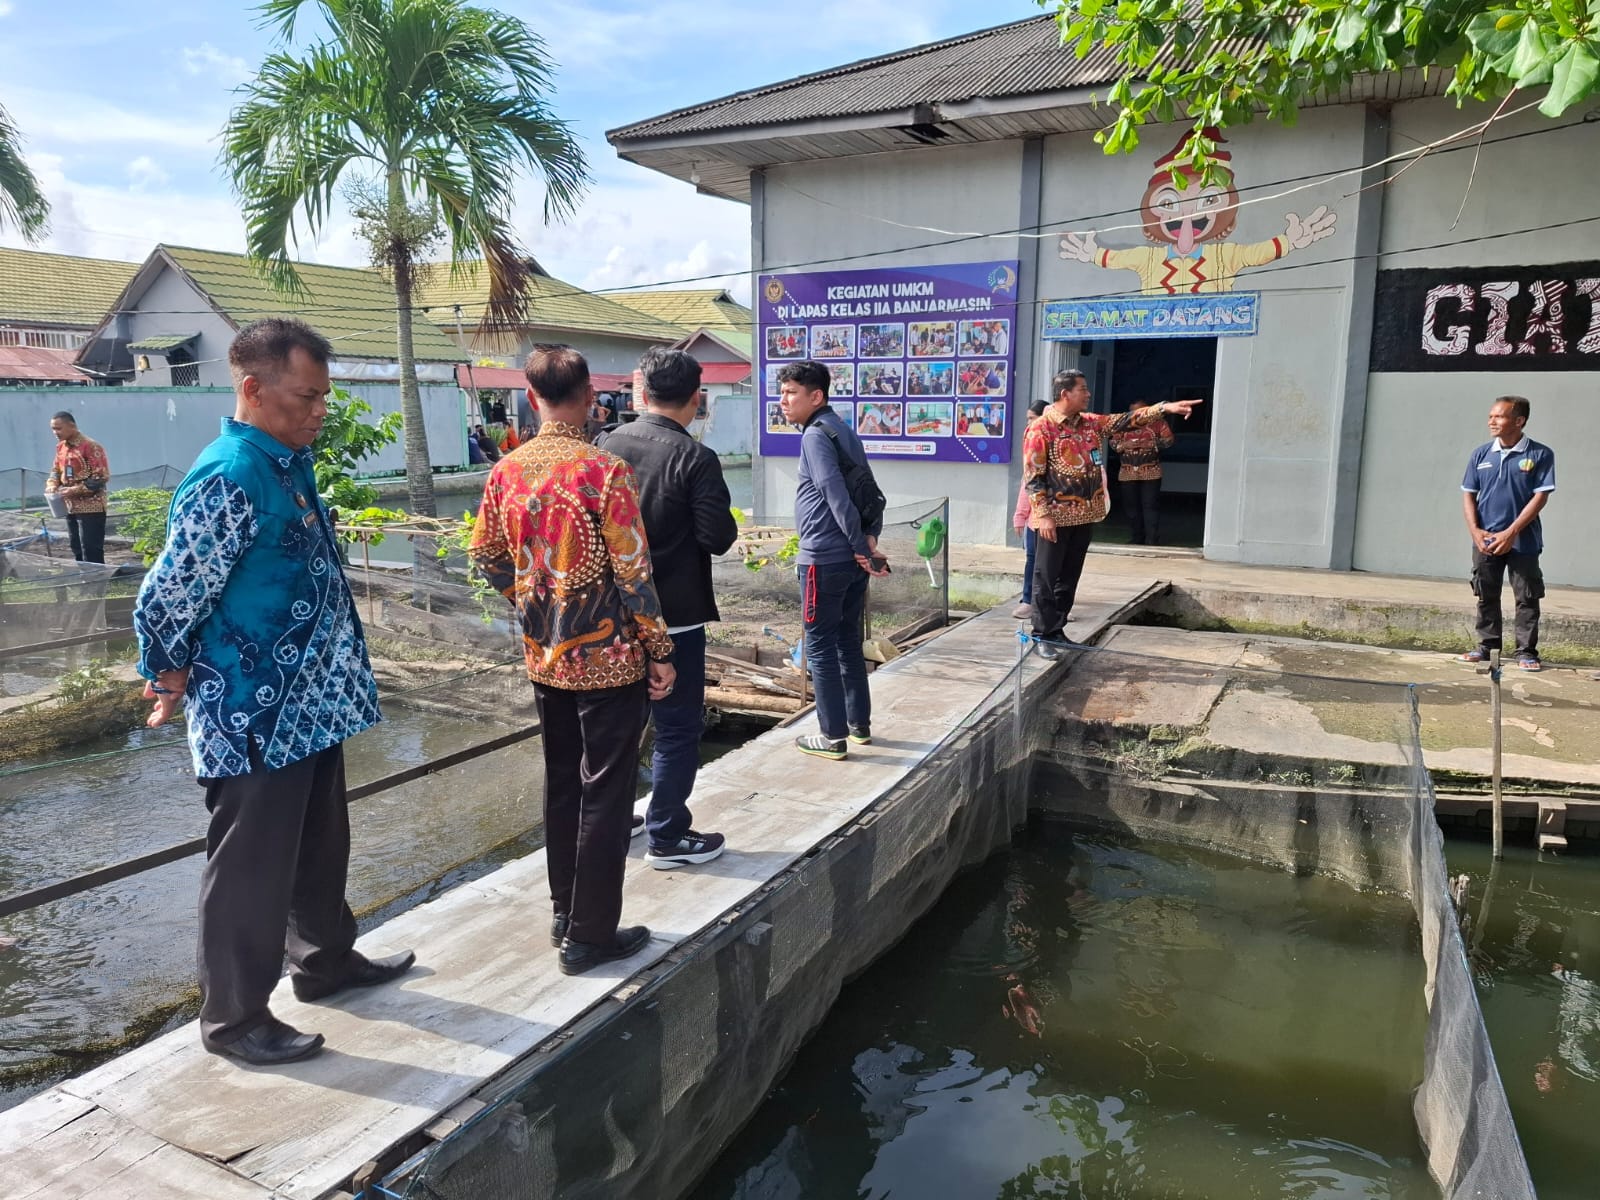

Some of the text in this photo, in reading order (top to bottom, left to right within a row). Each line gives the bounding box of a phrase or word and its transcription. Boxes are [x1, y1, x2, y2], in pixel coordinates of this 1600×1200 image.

[827, 282, 934, 300] KEGIATAN UMKM
[778, 297, 991, 319] DI LAPAS KELAS IIA BANJARMASIN
[1046, 306, 1251, 329] SELAMAT DATANG
